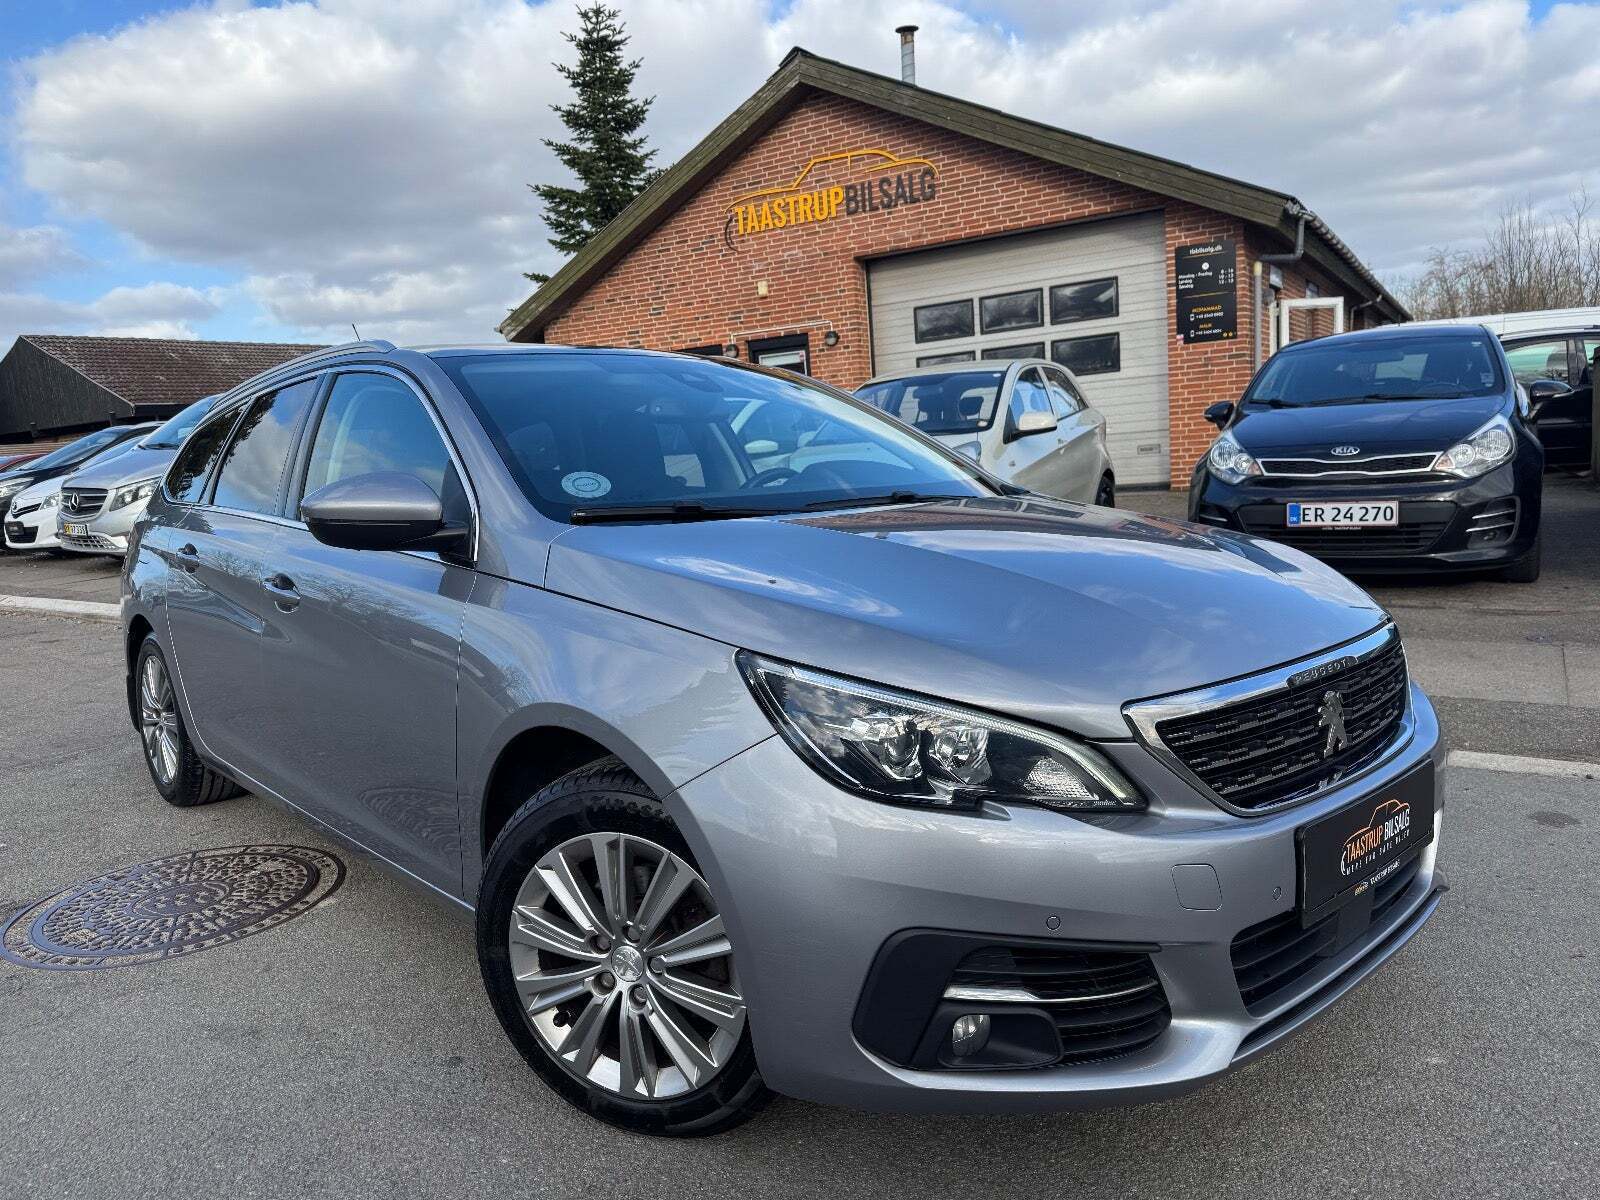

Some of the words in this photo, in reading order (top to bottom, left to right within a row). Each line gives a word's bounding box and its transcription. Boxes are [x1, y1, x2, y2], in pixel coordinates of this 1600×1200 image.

[1302, 507, 1325, 522] ER
[1331, 506, 1354, 522] 24
[1359, 505, 1394, 521] 270
[1346, 825, 1383, 864] TAASTRUP
[1384, 808, 1410, 841] BILSALG
